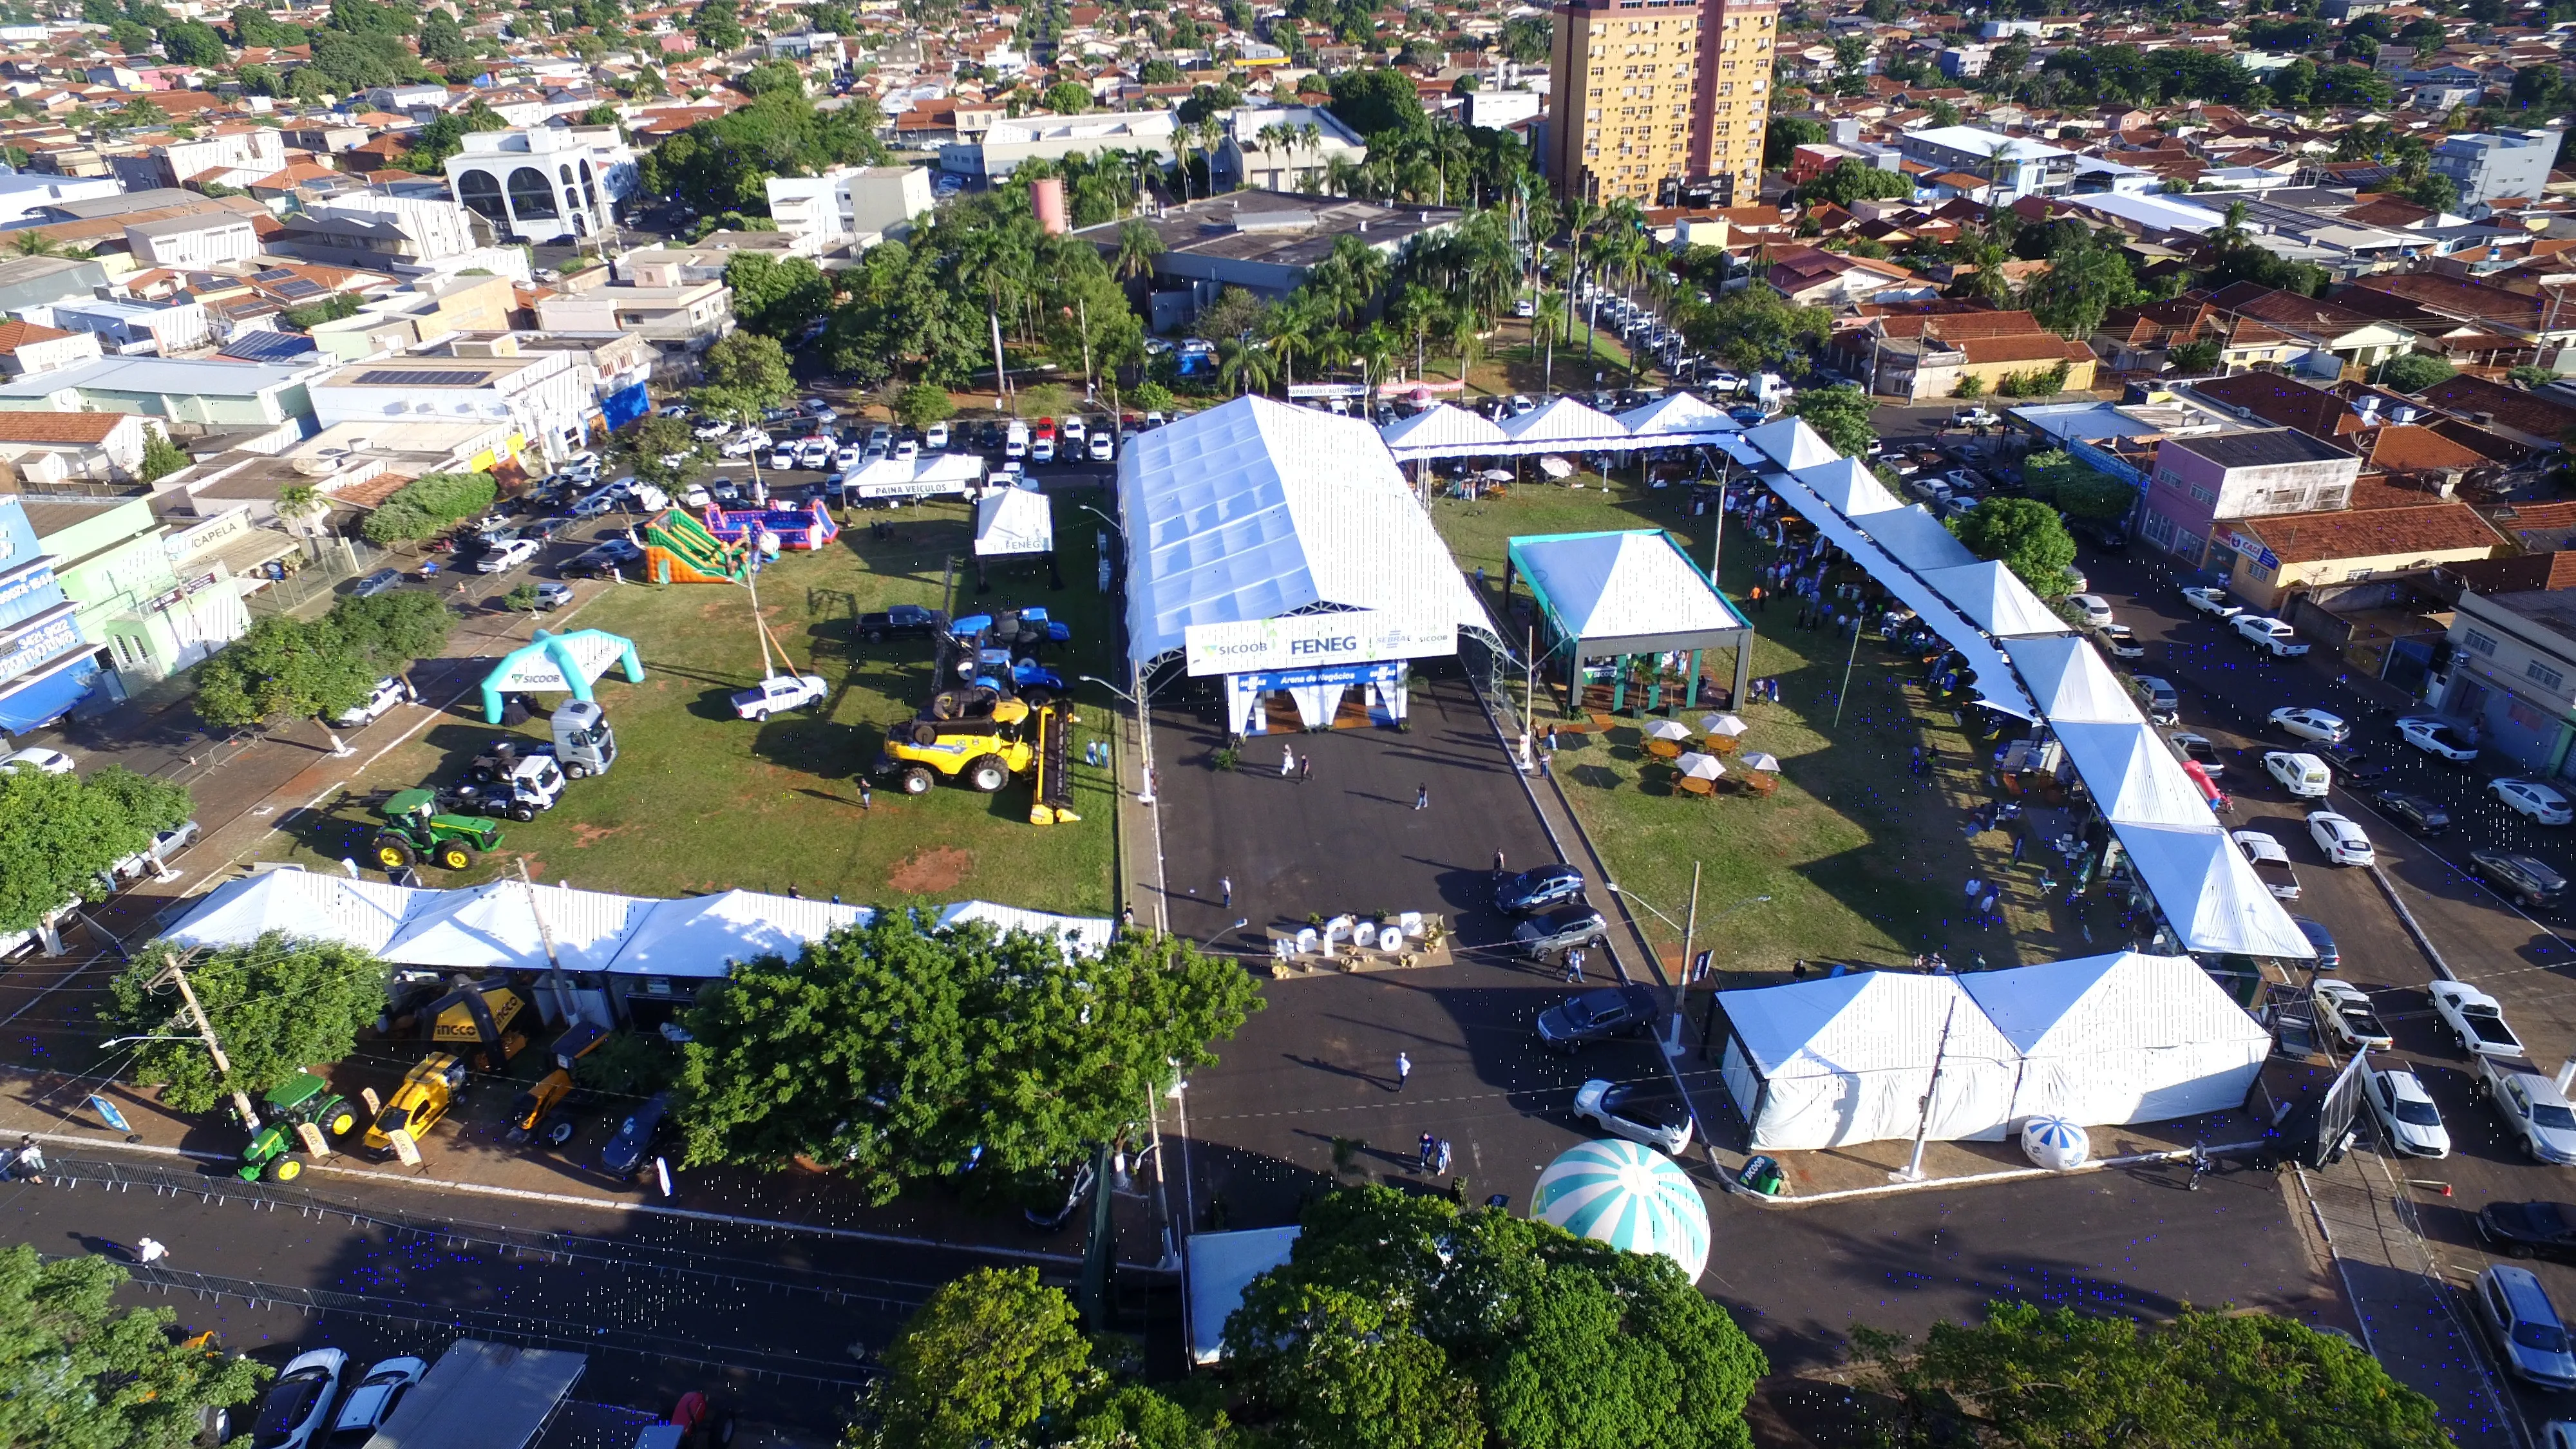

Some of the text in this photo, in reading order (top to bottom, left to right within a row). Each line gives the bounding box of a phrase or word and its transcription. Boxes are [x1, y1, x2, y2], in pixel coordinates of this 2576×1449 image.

[875, 484, 947, 495] PAINA VEÍCULOS
[193, 523, 237, 548] CAPELA
[1005, 540, 1040, 549] FENEG
[1376, 634, 1412, 644] SEBRAE
[1419, 634, 1448, 643] SICOOB
[1218, 643, 1267, 655] SICOOB
[1291, 636, 1357, 655] FENEG
[523, 674, 560, 683] SICOOB
[1280, 672, 1356, 685] Arena de Negócios
[1745, 1157, 1765, 1180] SICOOB
